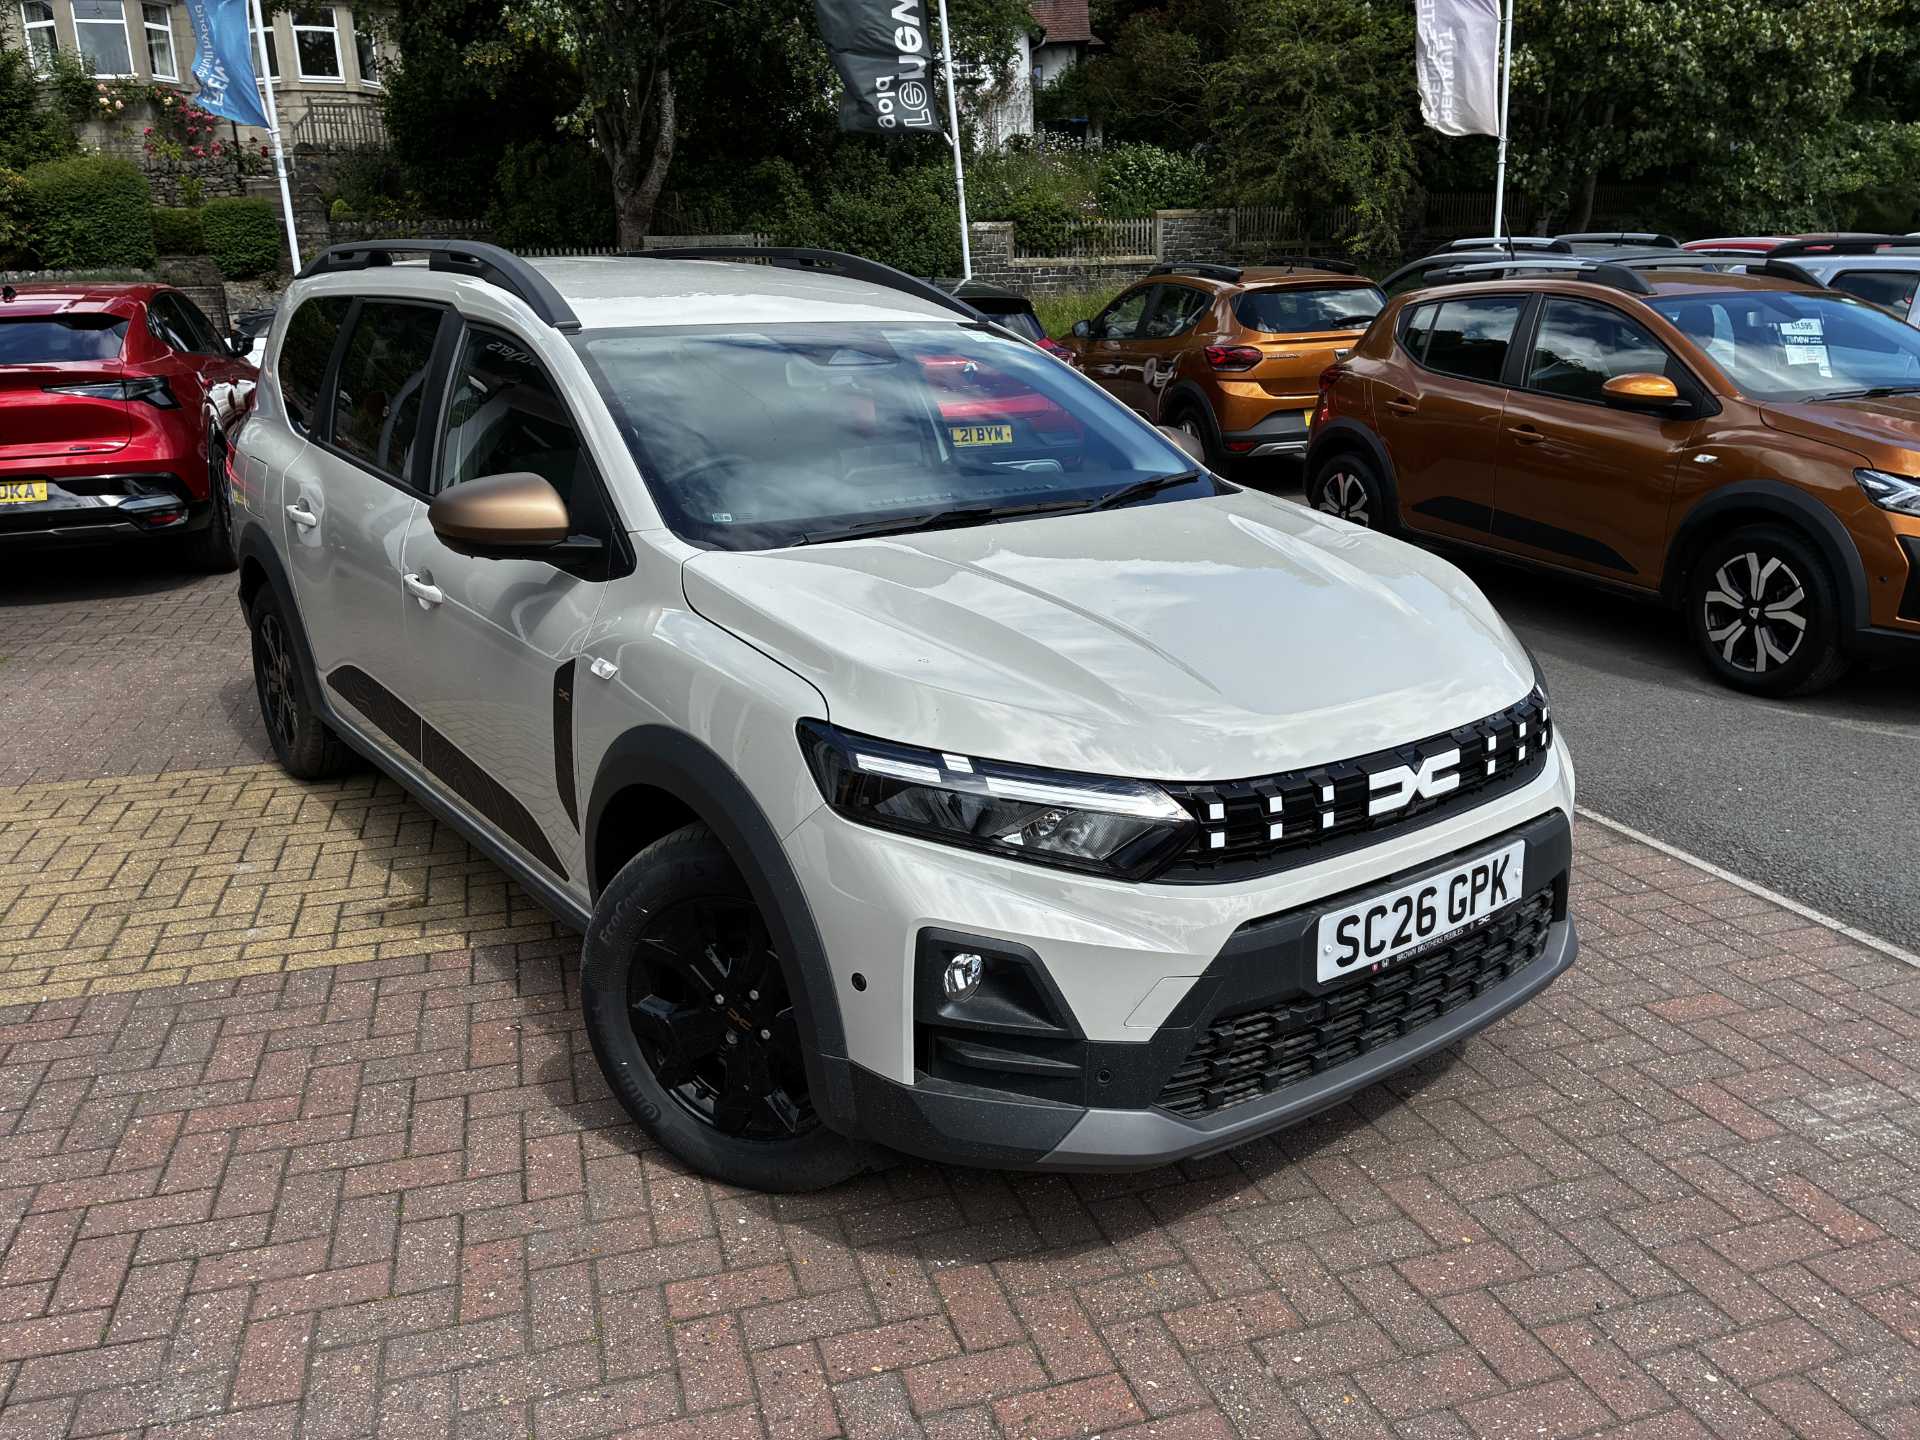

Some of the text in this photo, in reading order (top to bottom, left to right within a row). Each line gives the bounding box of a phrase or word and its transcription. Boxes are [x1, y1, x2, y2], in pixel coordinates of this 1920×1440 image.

[976, 427, 1004, 442] BYM
[1336, 853, 1511, 968] SC26 GPK
[1396, 928, 1464, 962] BROWN BROTHERS PEEBLES
